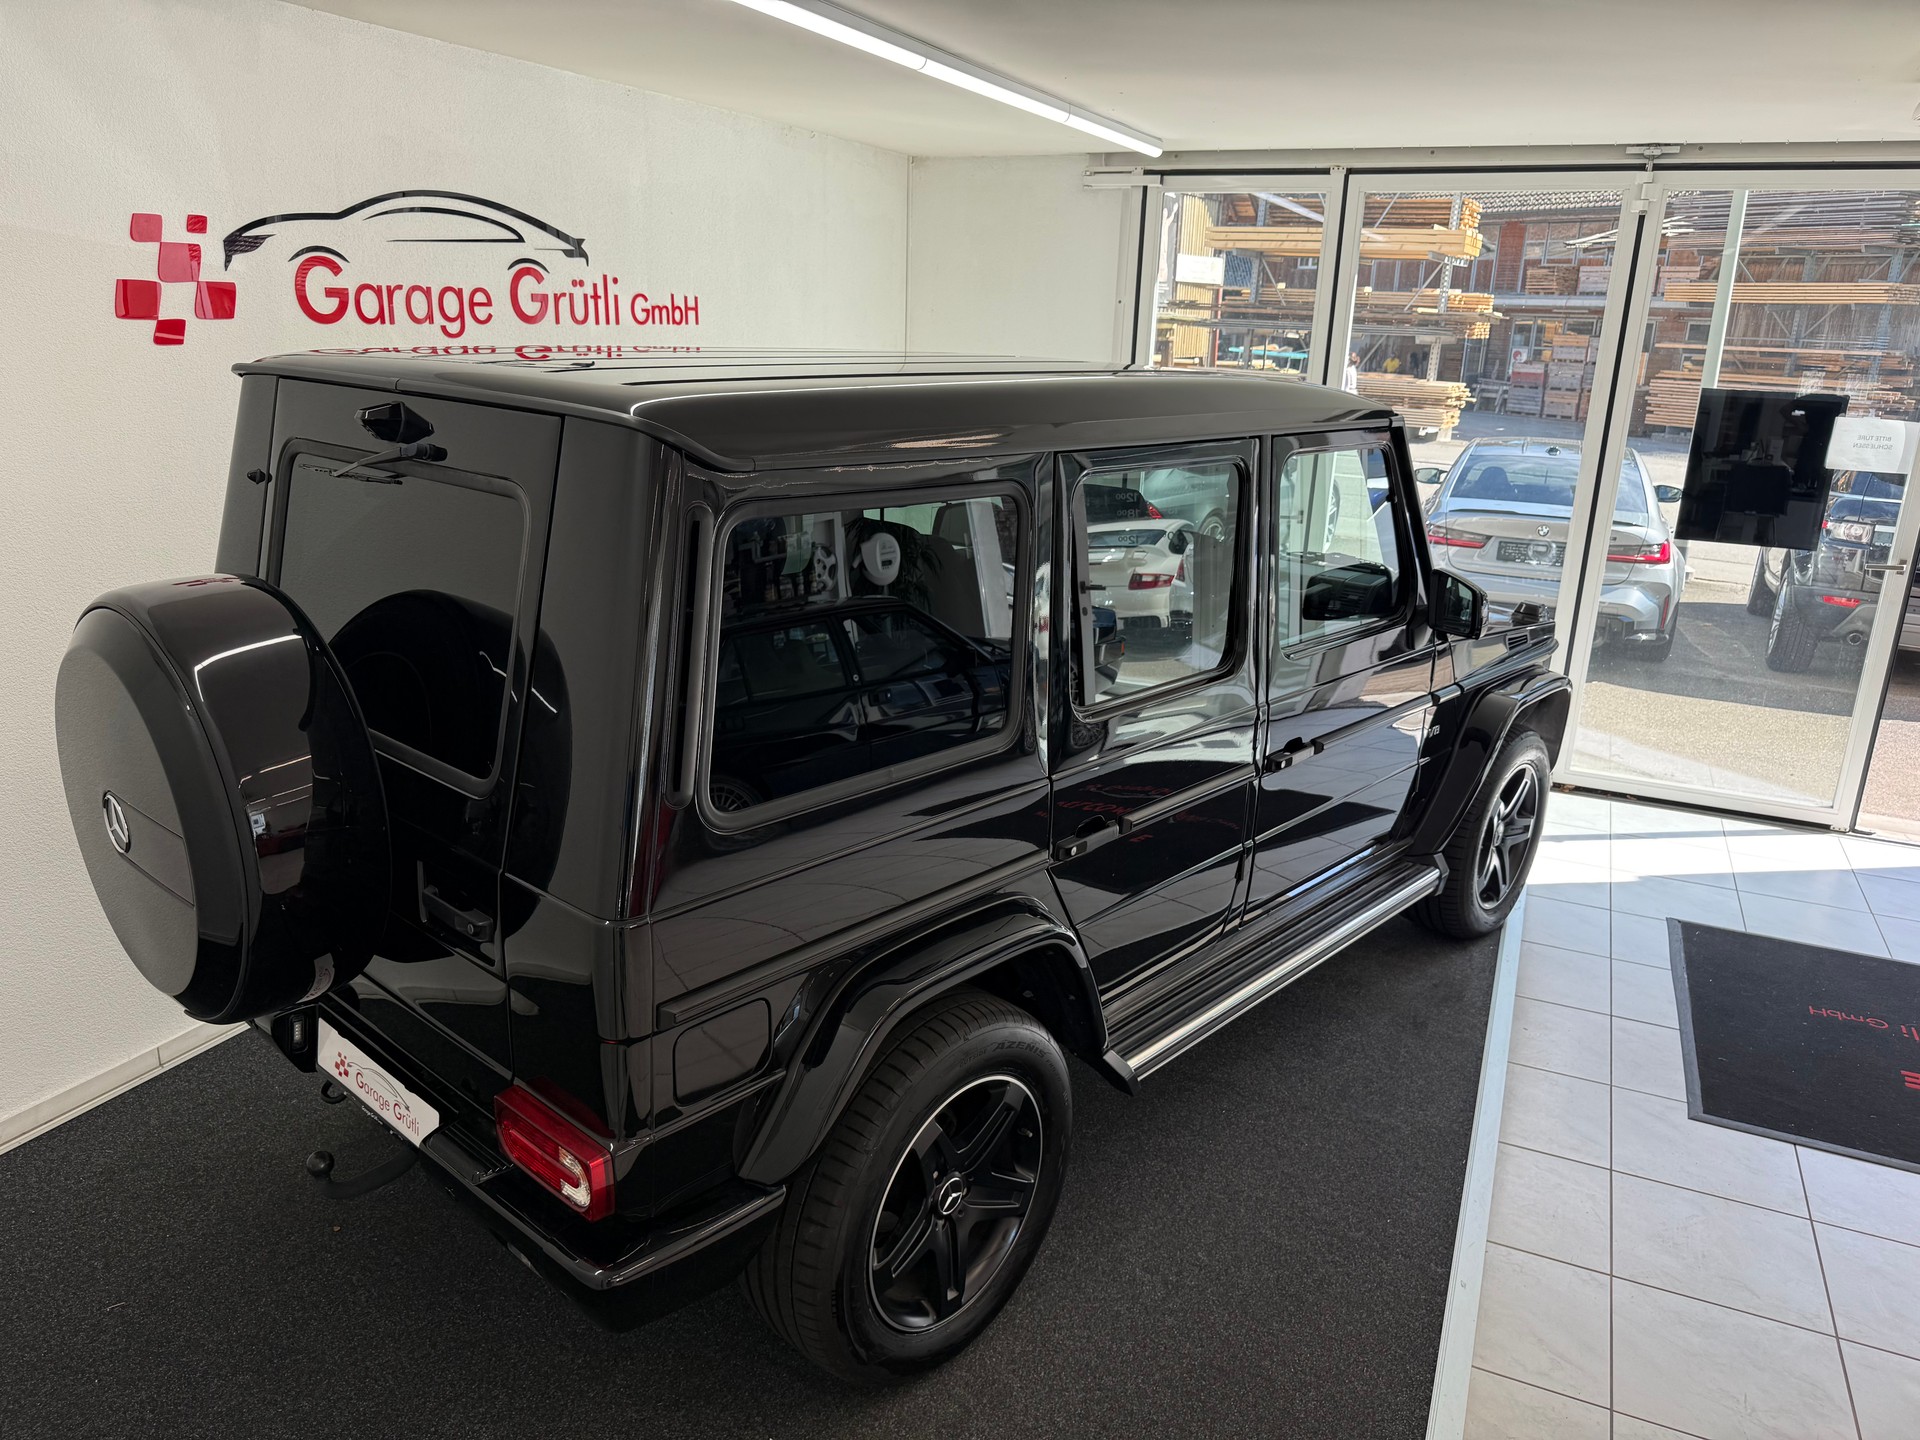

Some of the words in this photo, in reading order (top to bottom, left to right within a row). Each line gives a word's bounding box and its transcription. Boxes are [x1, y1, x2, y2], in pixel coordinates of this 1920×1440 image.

[295, 256, 493, 338] Garage
[510, 266, 621, 326] Grütli
[630, 294, 700, 326] GmbH
[1808, 1005, 1889, 1029] GmbH
[355, 1071, 391, 1112] Garage
[393, 1102, 421, 1137] Grütli
